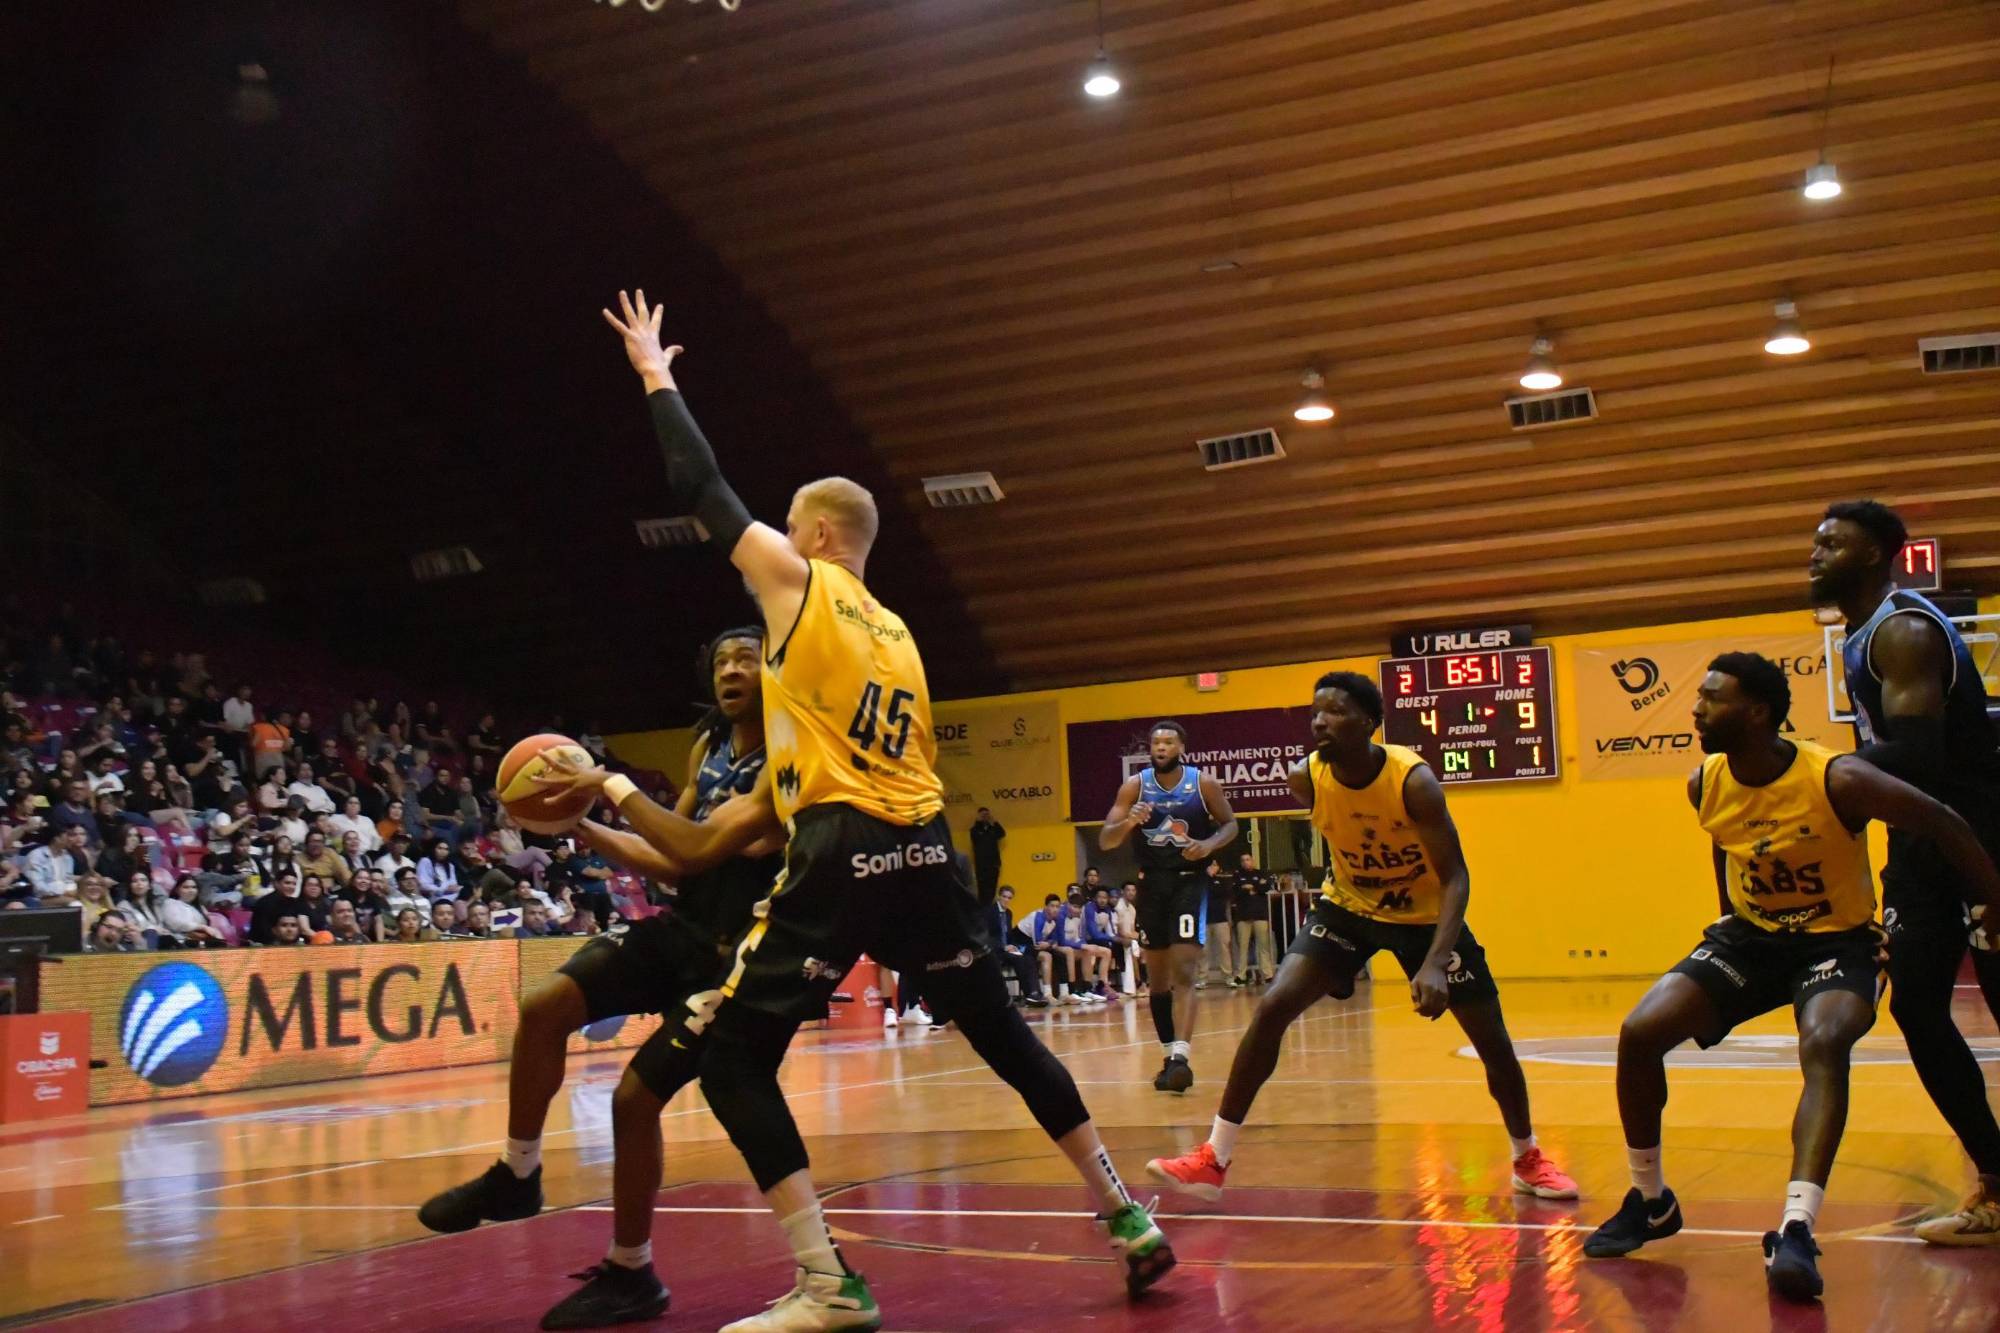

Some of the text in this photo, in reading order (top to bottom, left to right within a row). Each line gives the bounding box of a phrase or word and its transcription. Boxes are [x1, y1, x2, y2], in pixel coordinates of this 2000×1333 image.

[1905, 543, 1934, 575] 17
[1435, 629, 1511, 652] RULER
[1396, 664, 1411, 673] TOL
[1516, 654, 1532, 663] TOL
[1780, 655, 1828, 677] EGA
[1446, 655, 1500, 686] 6:51
[1518, 663, 1533, 685] 2
[1399, 673, 1413, 694] 2
[1395, 695, 1439, 709] GUEST
[1495, 687, 1535, 702] HOME
[1630, 682, 1671, 711] Berel
[848, 680, 915, 759] 45
[1420, 709, 1438, 735] 4
[1465, 702, 1474, 722] 1
[1518, 702, 1536, 729] 9
[1448, 723, 1487, 736] PERIOD
[1440, 738, 1498, 750] PLAYER-FOUL
[1515, 736, 1543, 745] FOULS
[1595, 733, 1693, 753] VENTO
[1285, 745, 1305, 758] DE
[1444, 751, 1470, 772] 04
[1488, 749, 1495, 769] 1
[1533, 745, 1541, 767] 1
[1443, 771, 1473, 781] MATCH
[1515, 766, 1547, 777] POINTS
[992, 785, 1052, 800] VOCABLO
[1179, 914, 1195, 938] 0
[1448, 970, 1475, 984] EGA
